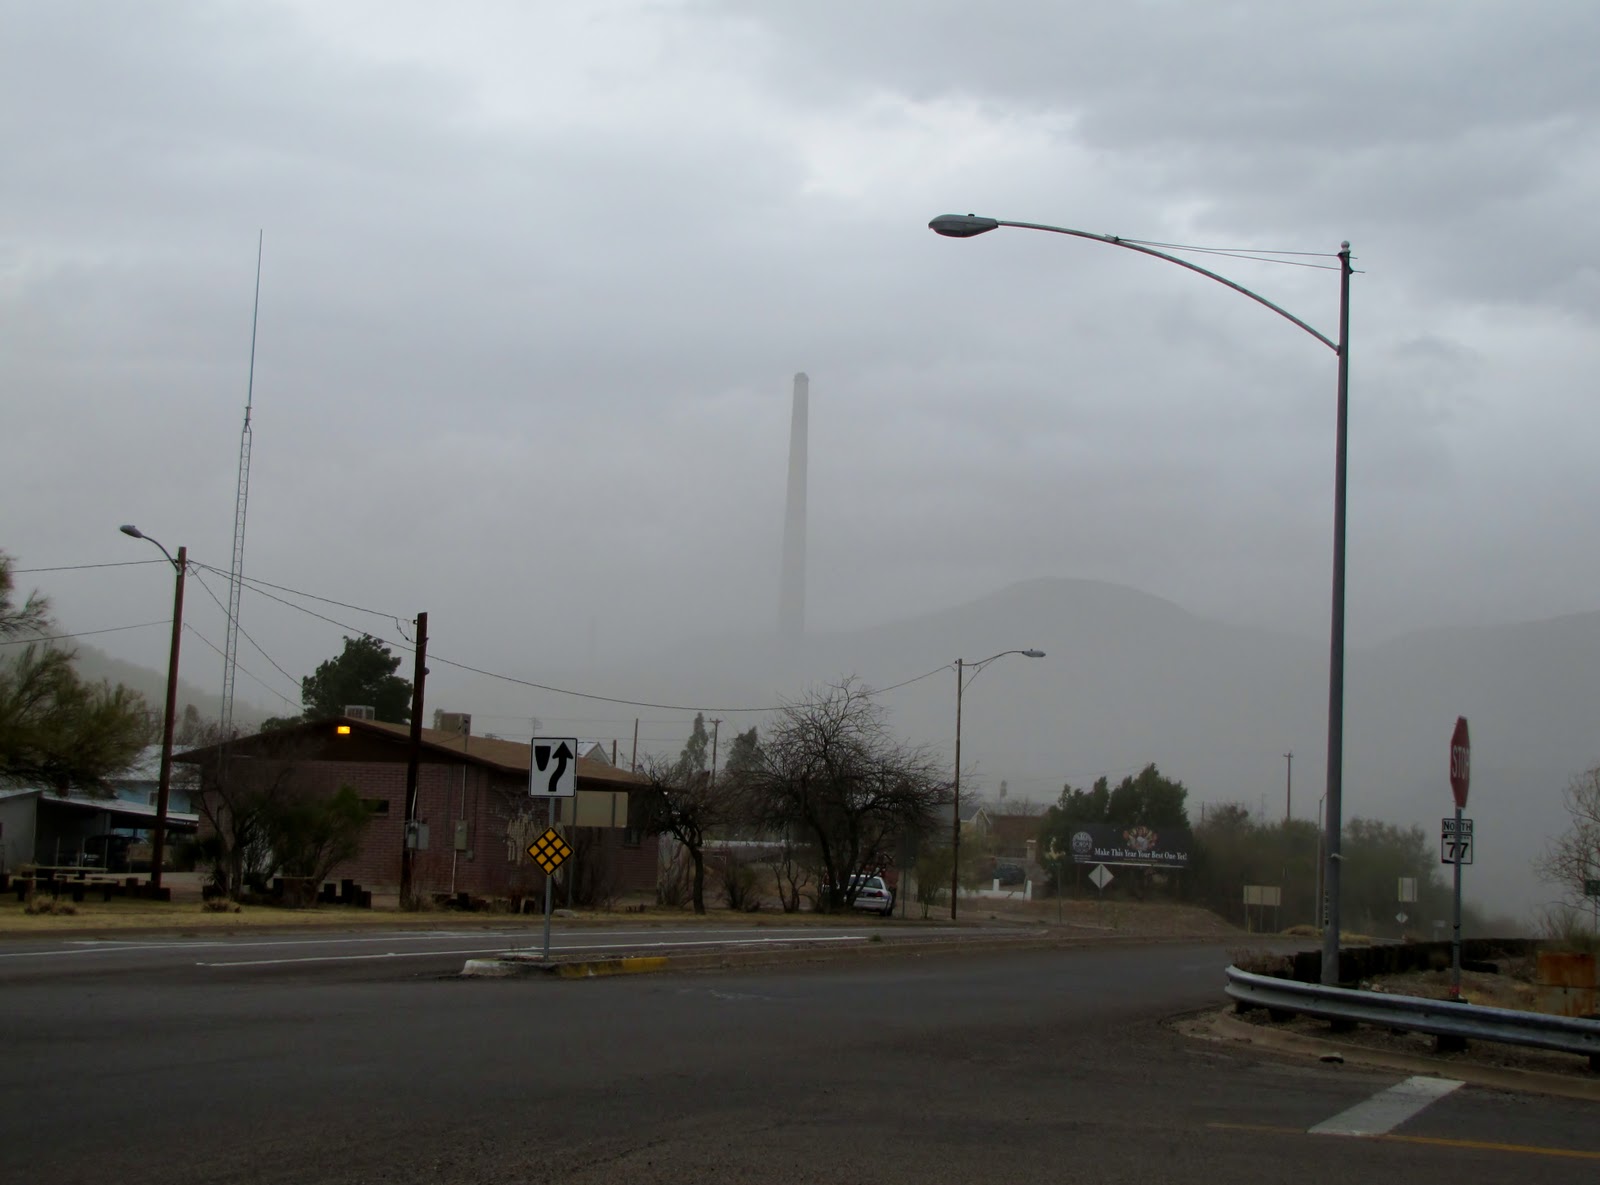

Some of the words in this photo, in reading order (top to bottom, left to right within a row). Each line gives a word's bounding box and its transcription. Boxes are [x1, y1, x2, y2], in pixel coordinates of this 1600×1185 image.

[1452, 744, 1469, 780] STOP
[1443, 821, 1471, 831] NOTH
[1094, 848, 1110, 857] Make
[1111, 848, 1123, 857] This
[1124, 849, 1137, 858] Year
[1138, 849, 1151, 858] Your
[1151, 850, 1164, 859] Best
[1164, 851, 1176, 860] One
[1446, 842, 1468, 858] 77
